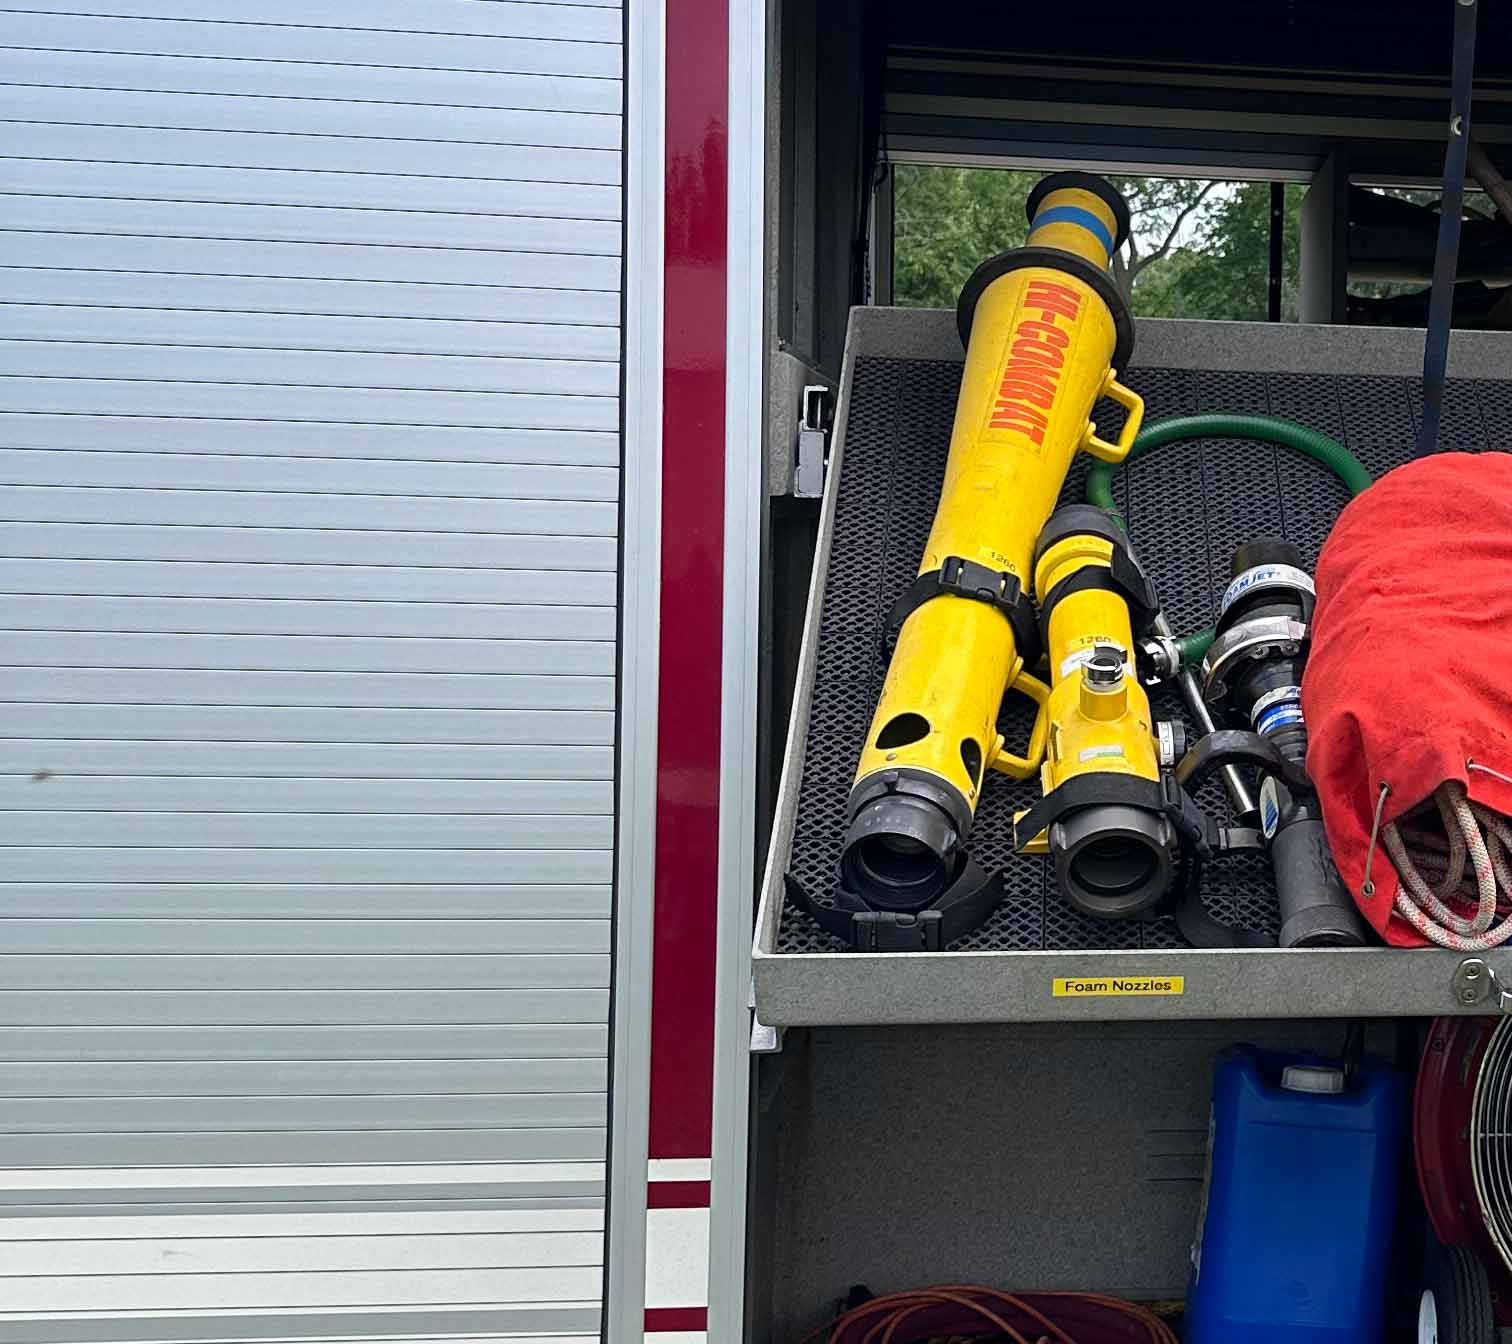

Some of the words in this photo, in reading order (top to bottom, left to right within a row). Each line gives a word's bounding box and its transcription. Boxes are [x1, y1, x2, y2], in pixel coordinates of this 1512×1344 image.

[989, 280, 1082, 447] HI-COMBAT
[1065, 980, 1108, 993] Foam
[1112, 979, 1172, 992] Nozzles
